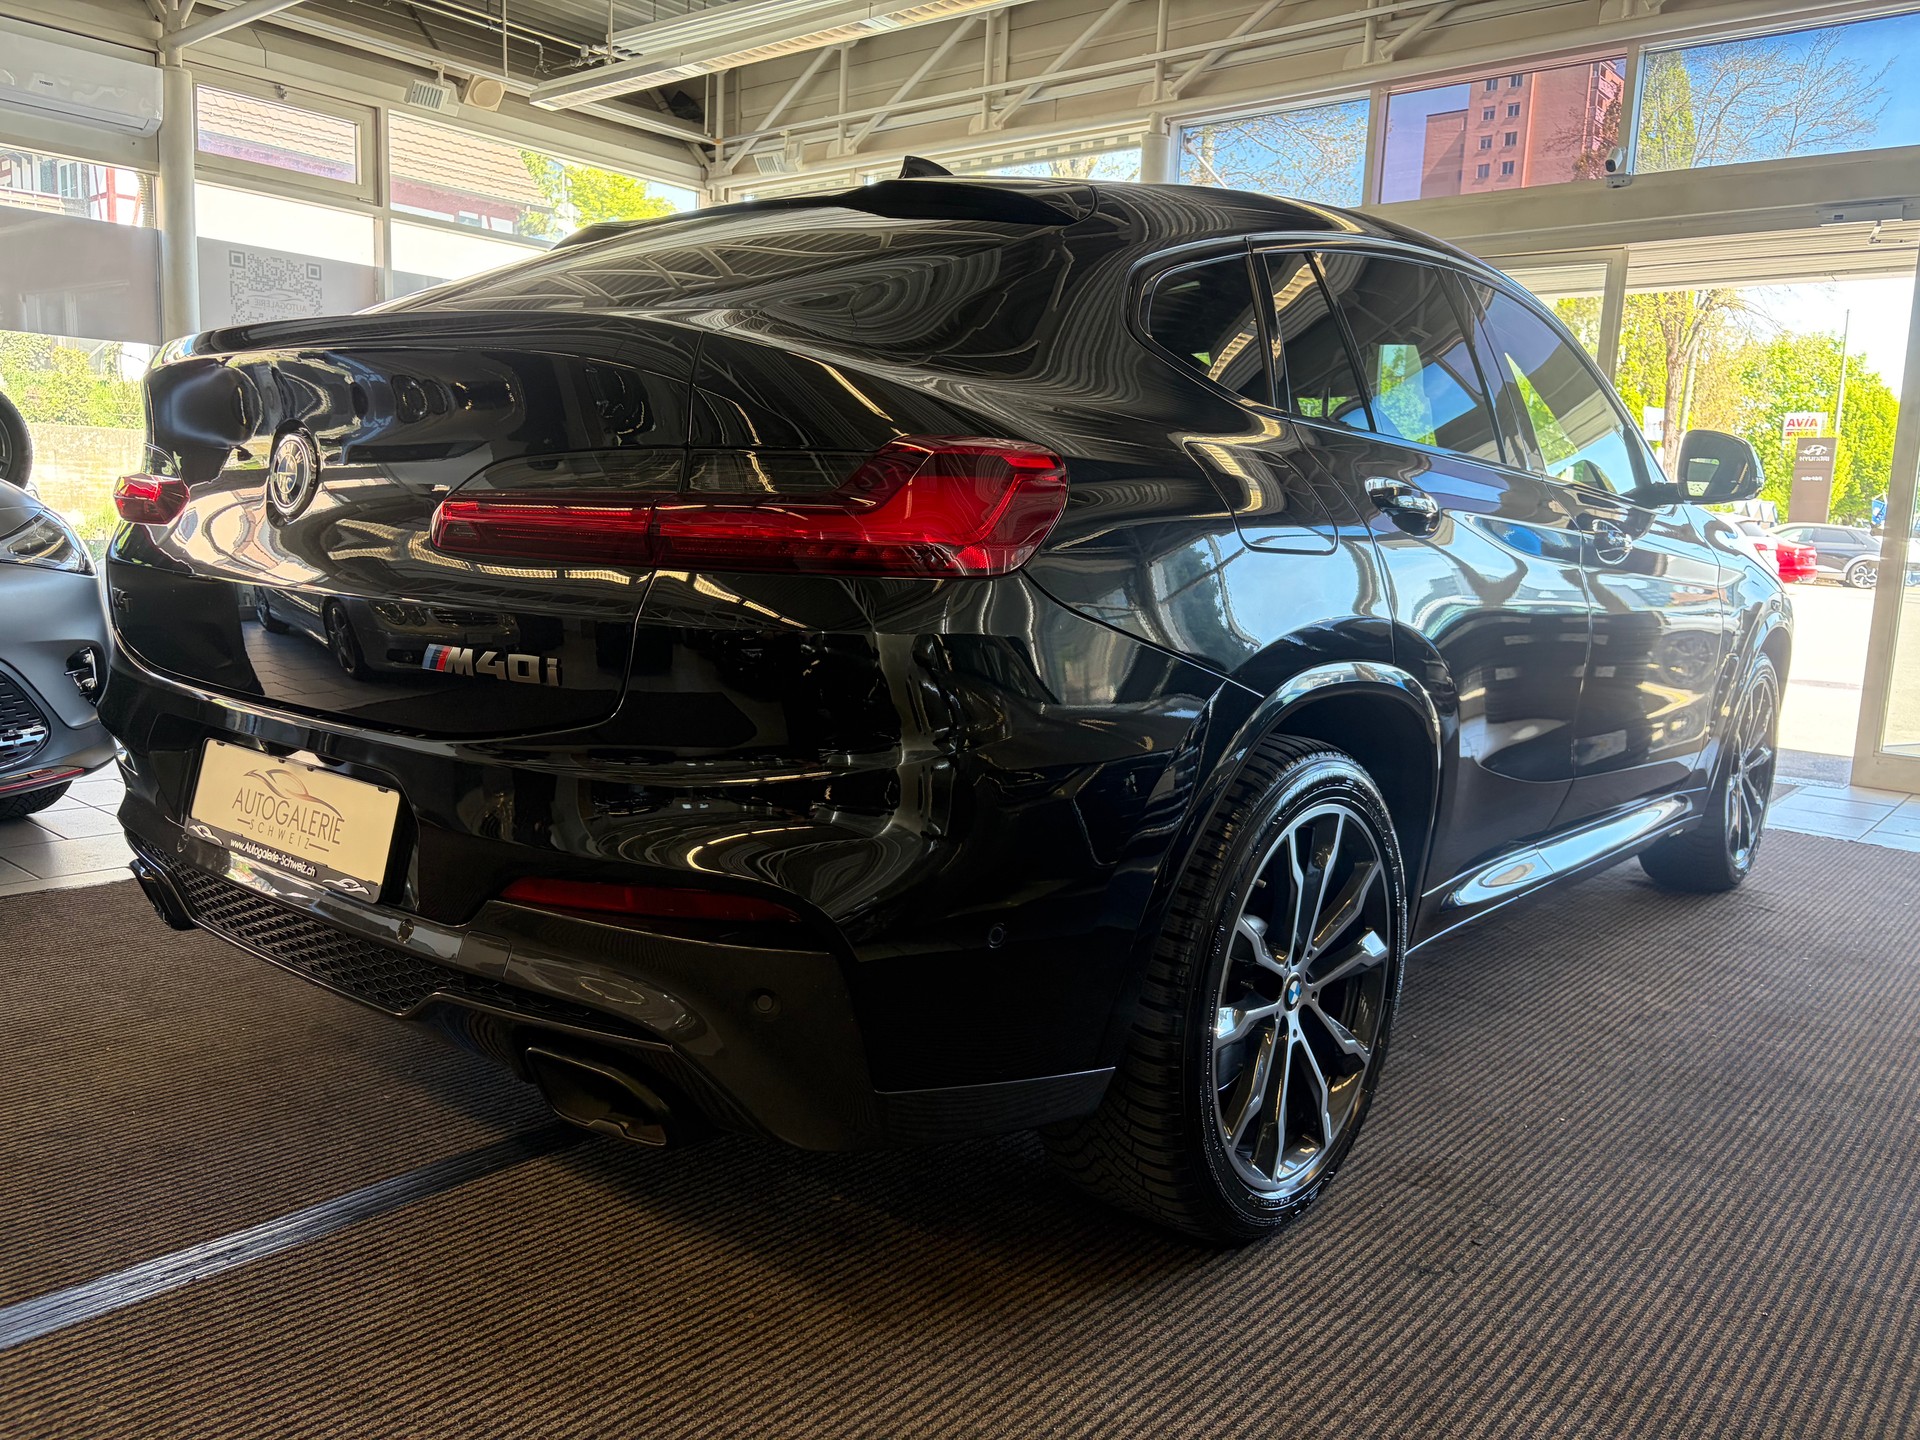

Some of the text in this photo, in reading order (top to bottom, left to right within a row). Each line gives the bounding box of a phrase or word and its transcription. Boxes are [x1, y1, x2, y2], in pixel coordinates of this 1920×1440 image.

[444, 646, 559, 687] M40i
[231, 786, 346, 846] AUTOGALERIE
[248, 818, 311, 851] SCHWEIZ
[229, 837, 317, 877] www.Autogalerie-Schweiz.ch
